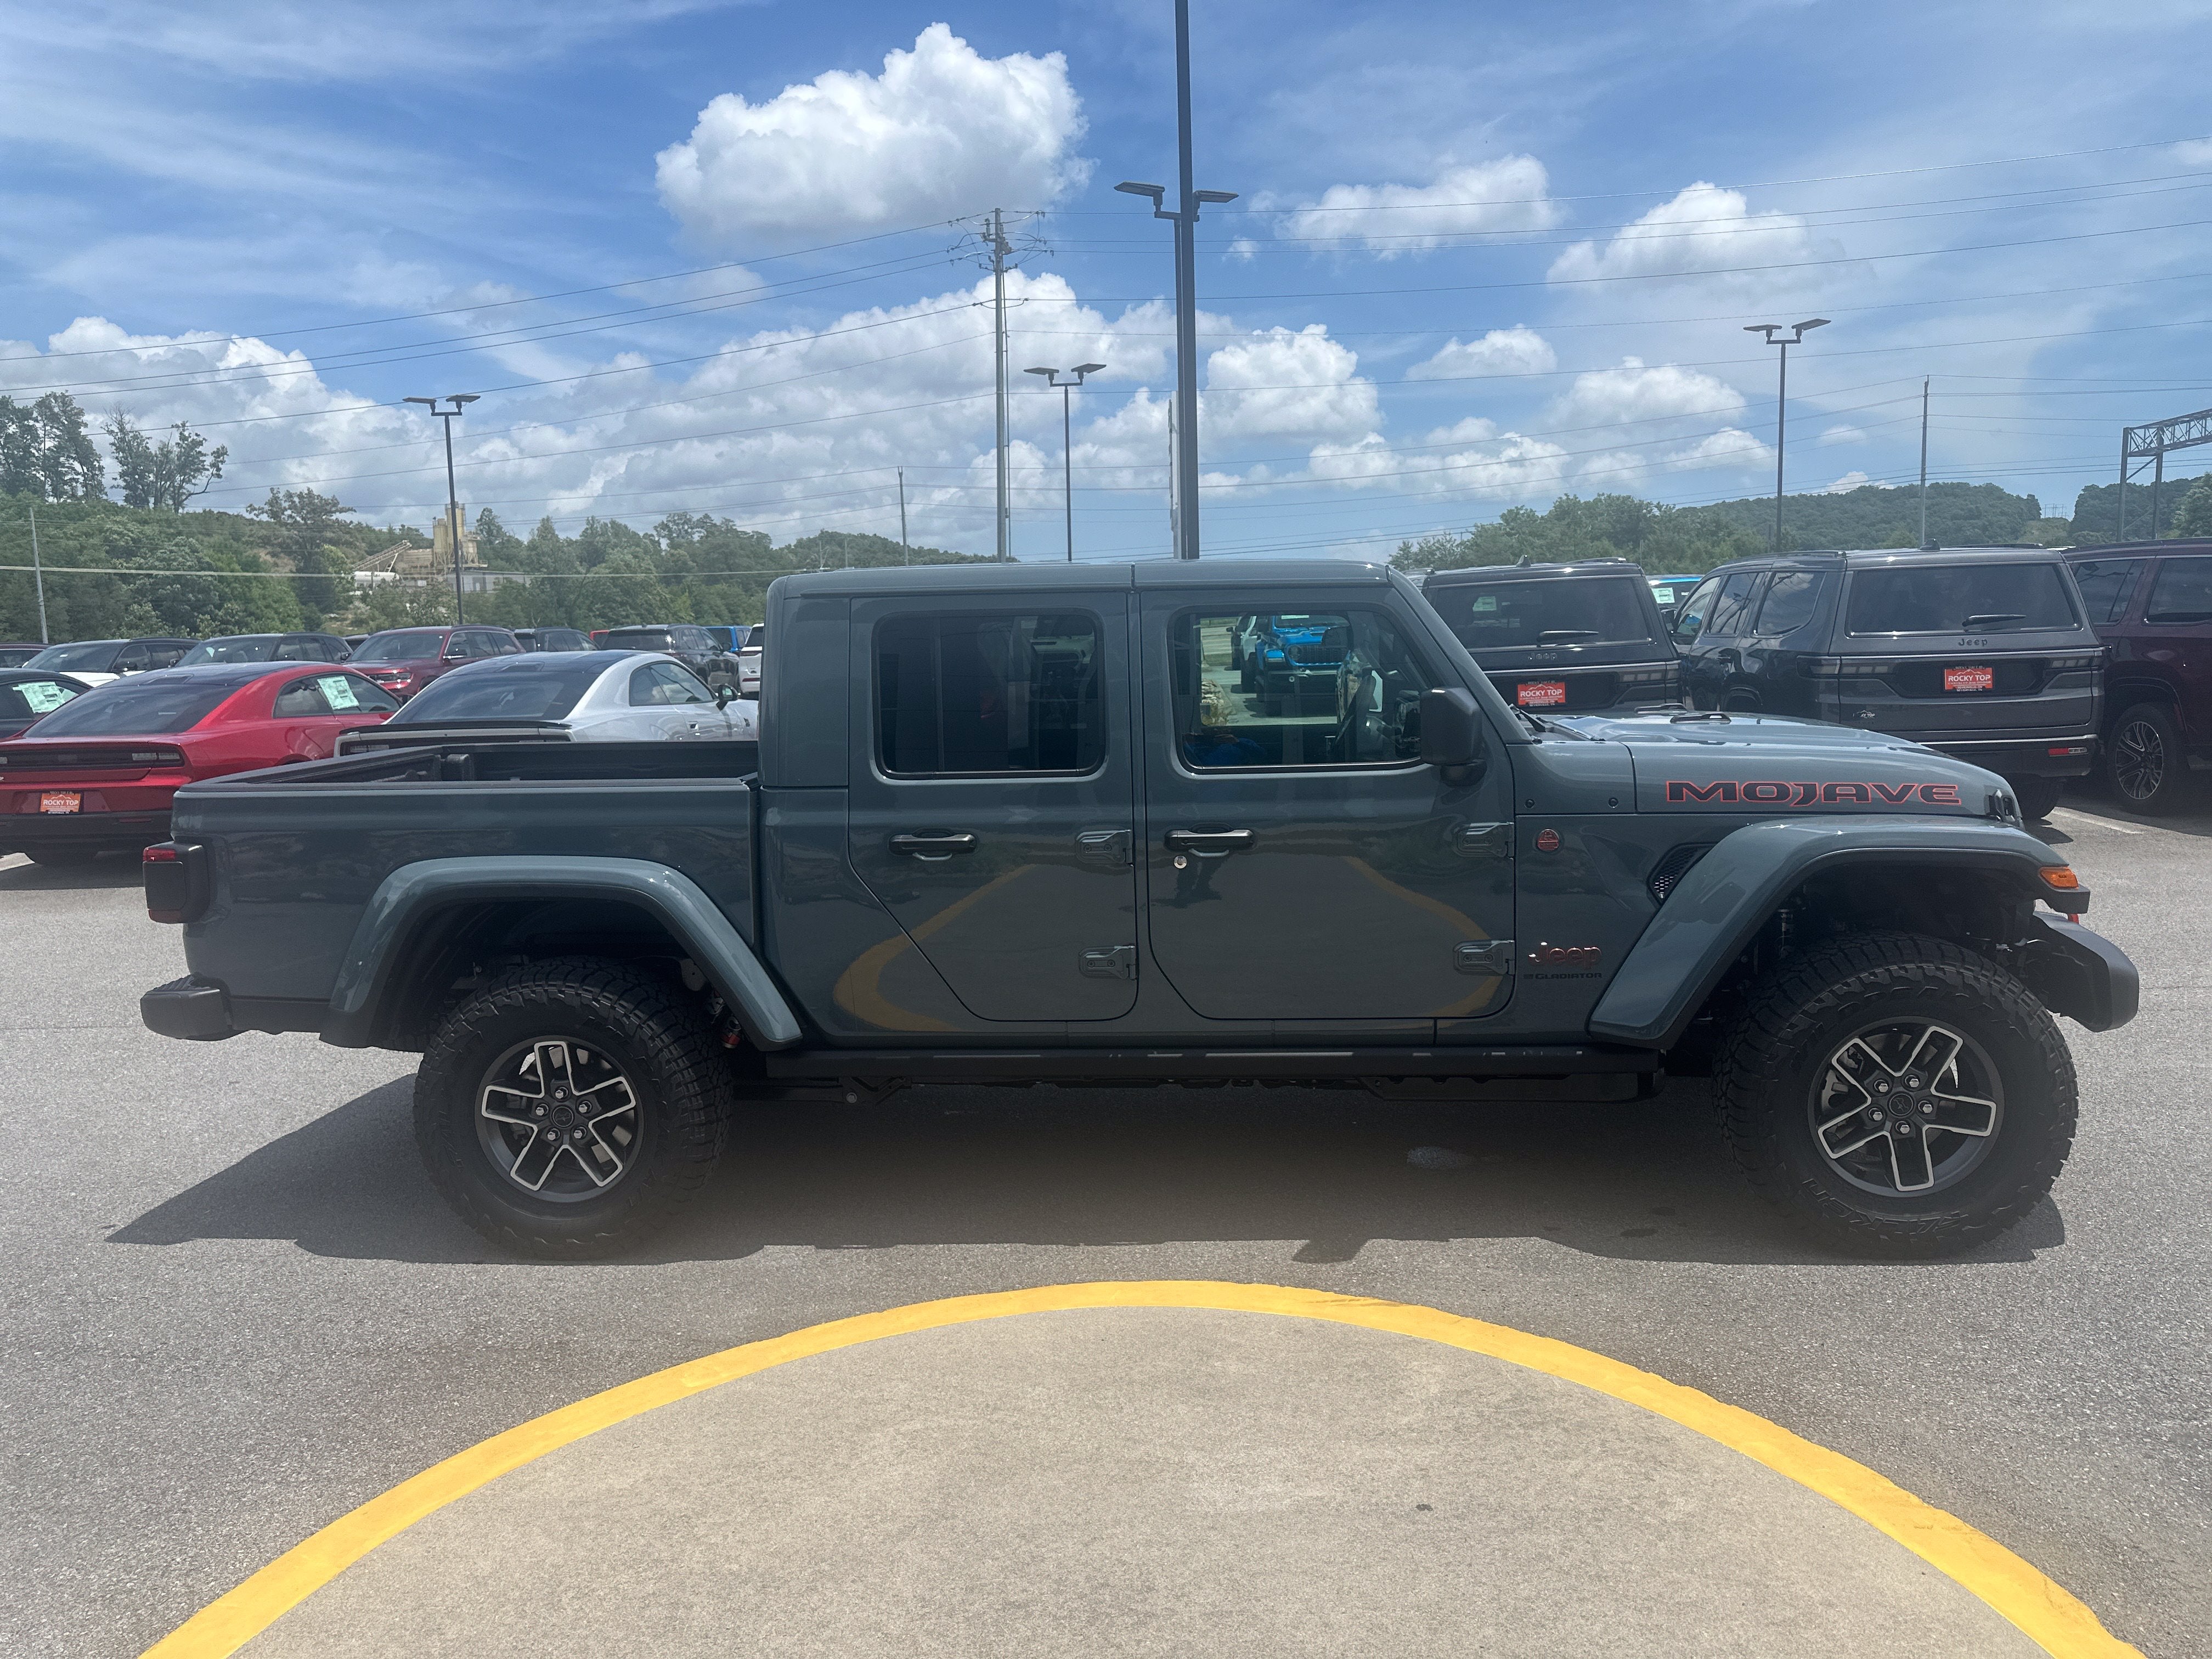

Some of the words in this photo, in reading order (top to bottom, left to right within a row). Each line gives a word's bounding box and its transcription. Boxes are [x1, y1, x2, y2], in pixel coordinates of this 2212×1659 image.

[1958, 638, 1988, 646] Jeep
[1666, 781, 1962, 807] MOJAVE
[1528, 941, 1602, 970] Jeep
